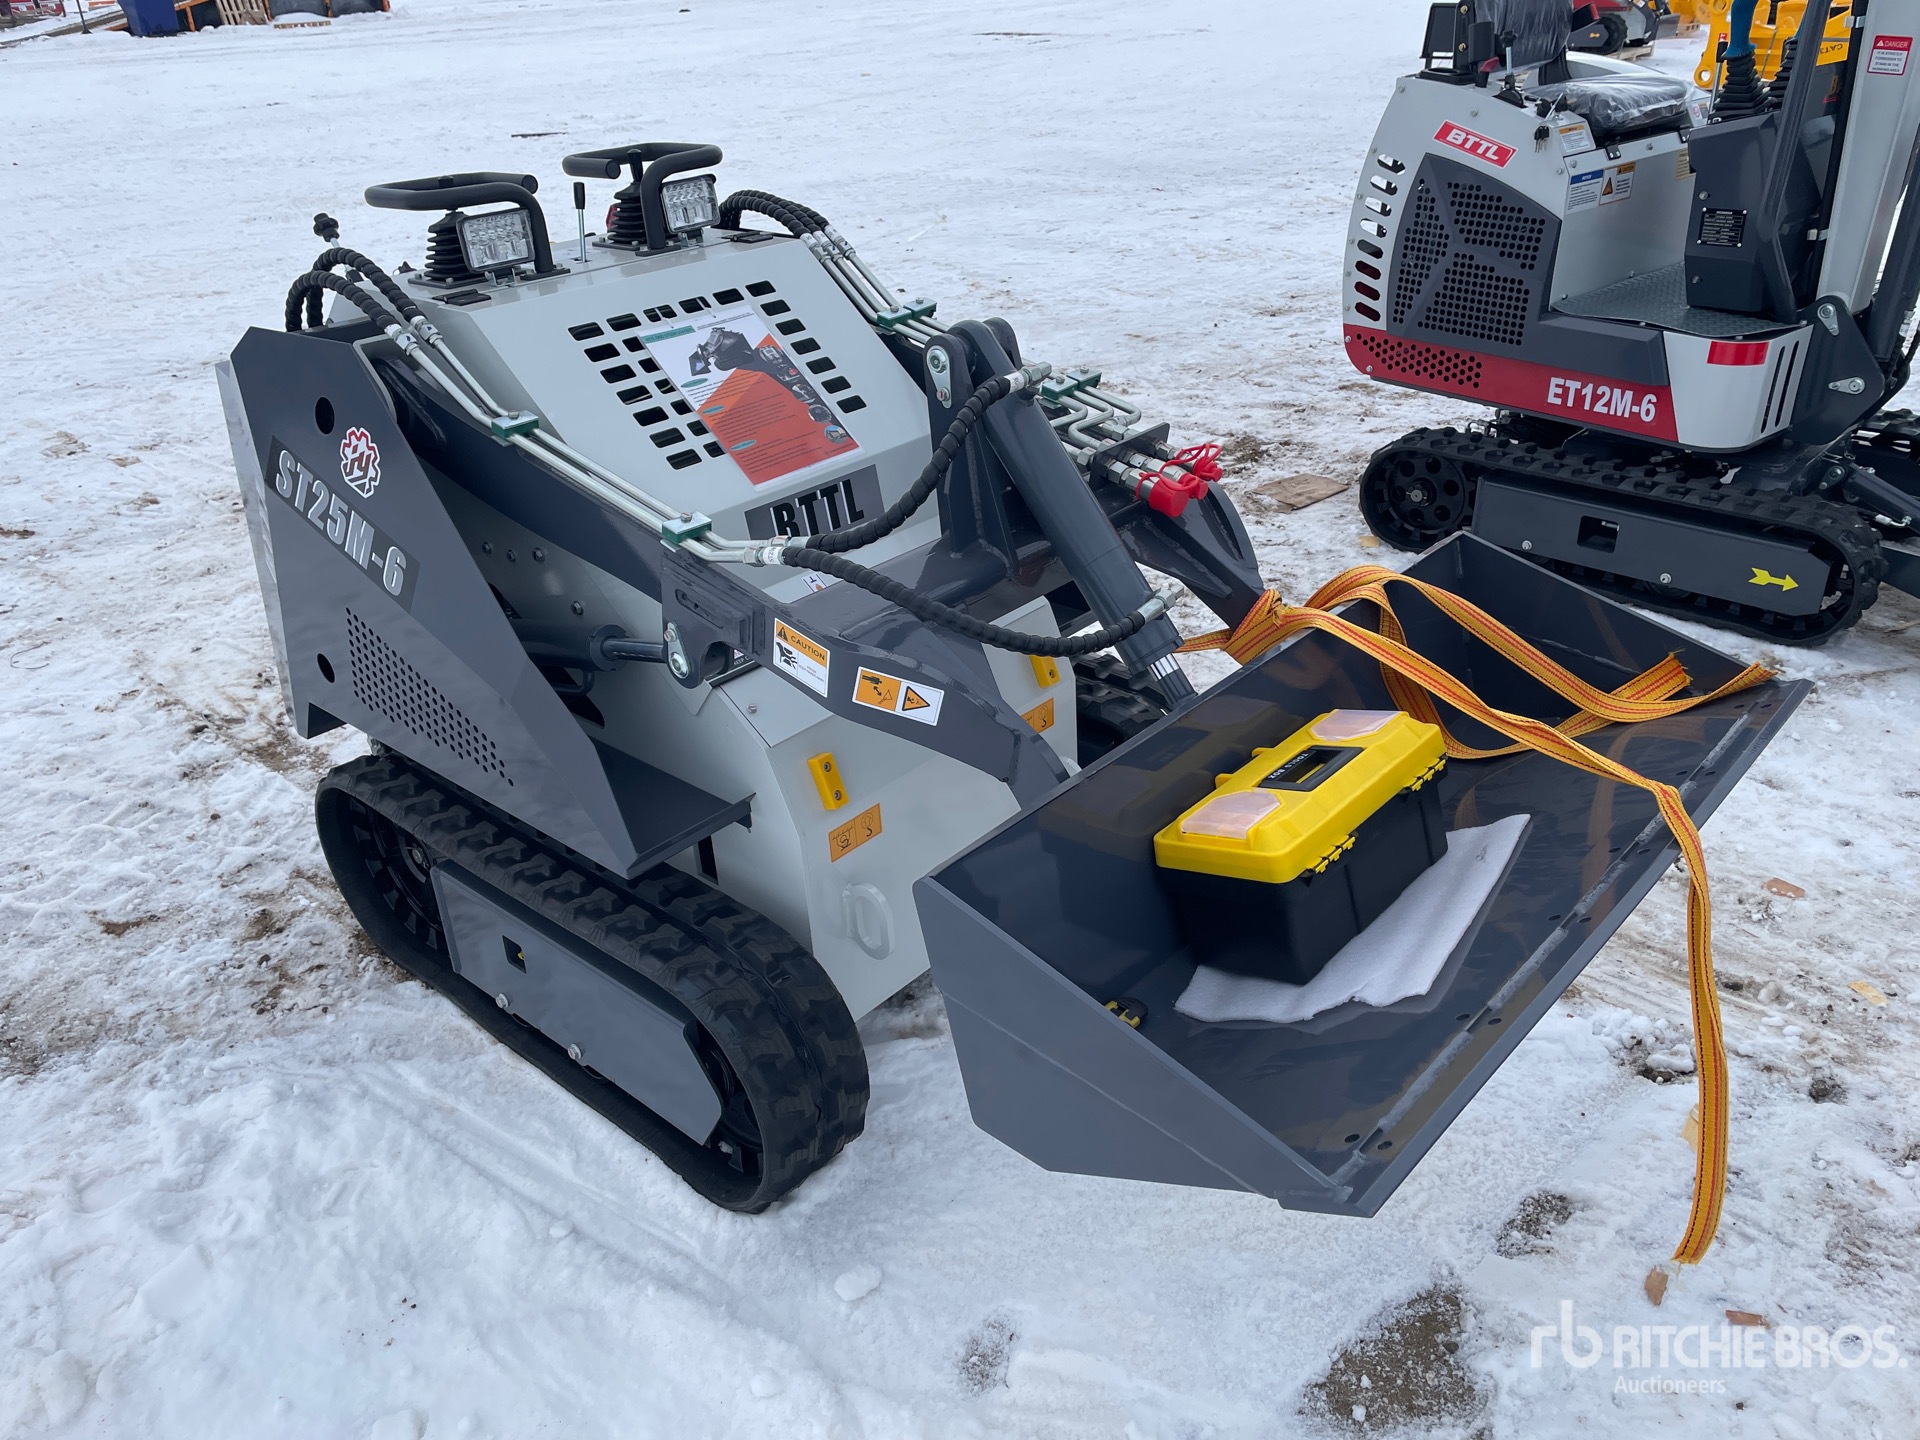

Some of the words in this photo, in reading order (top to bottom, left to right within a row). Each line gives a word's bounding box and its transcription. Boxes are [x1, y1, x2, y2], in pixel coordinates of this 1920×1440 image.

[1446, 128, 1499, 161] BTTL
[1547, 376, 1658, 423] ET12M-6
[275, 449, 407, 597] ST25M-6
[790, 635, 826, 661] CAUTION
[1267, 768, 1286, 779] BOX
[1284, 753, 1309, 768] TOOLS
